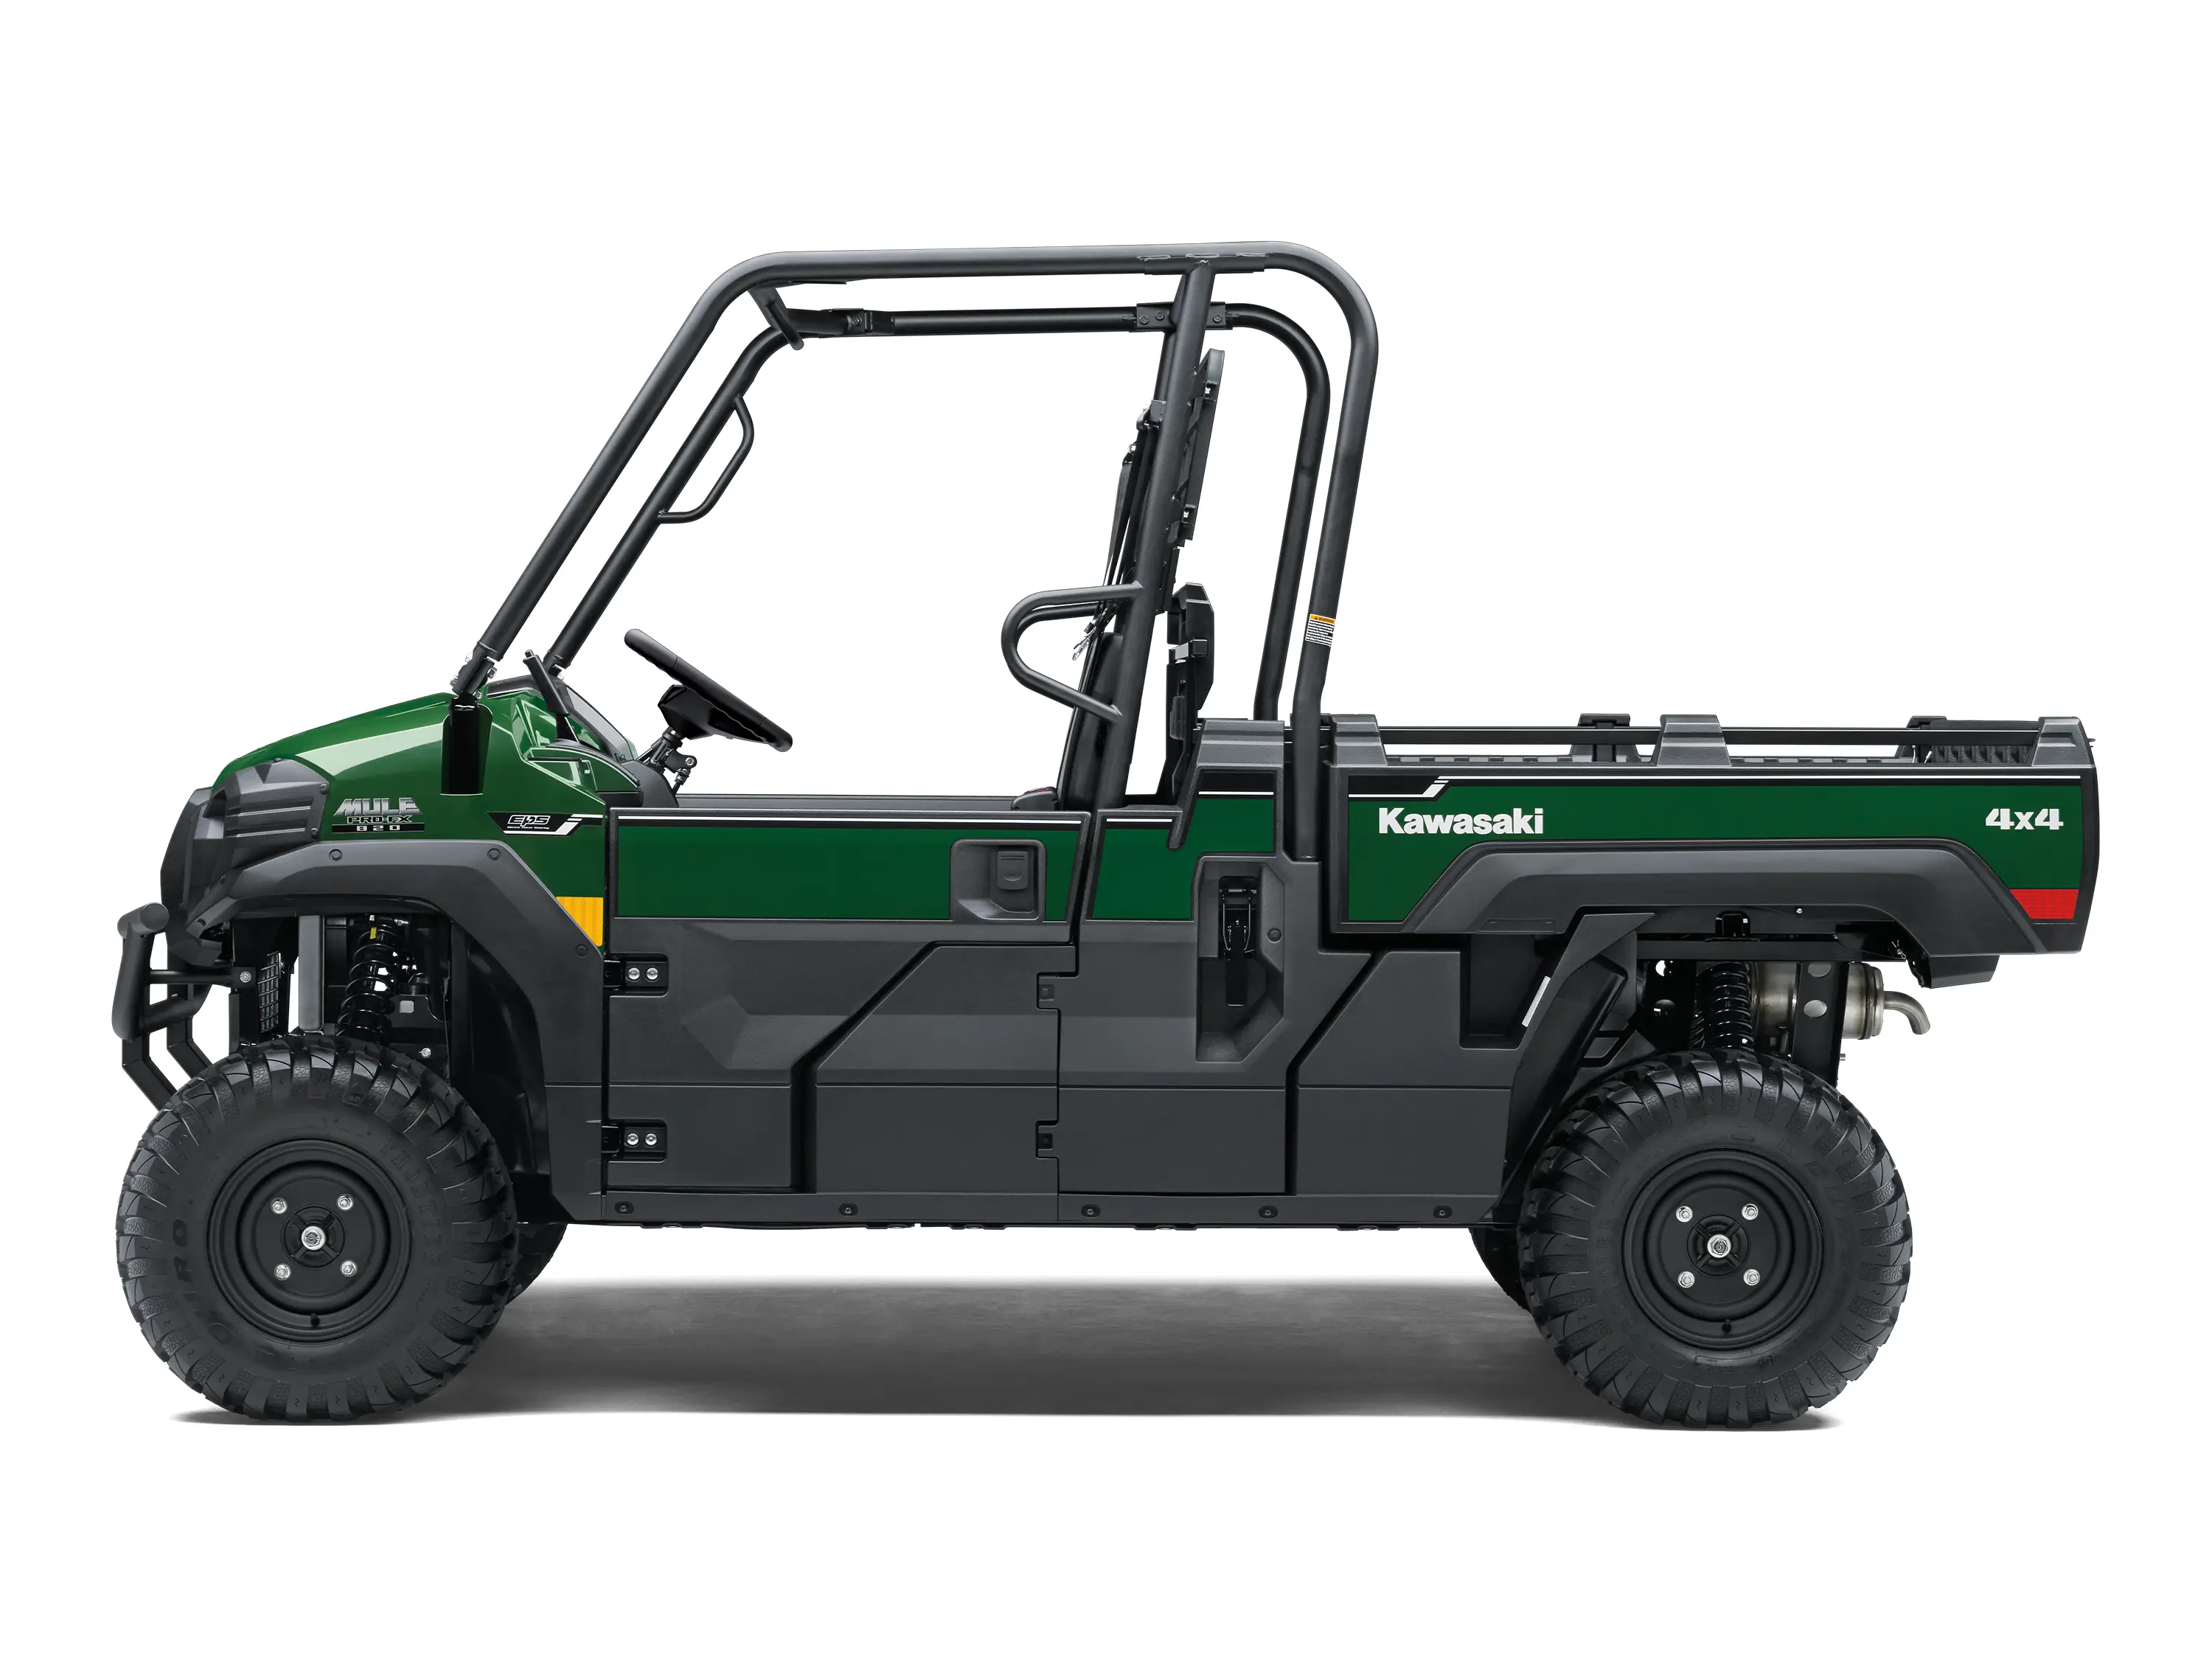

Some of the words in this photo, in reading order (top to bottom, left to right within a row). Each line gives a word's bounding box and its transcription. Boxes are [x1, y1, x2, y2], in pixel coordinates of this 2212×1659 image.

[333, 797, 422, 816] MULE
[1379, 807, 1544, 835] Kawasaki
[1985, 808, 2064, 830] 4x4
